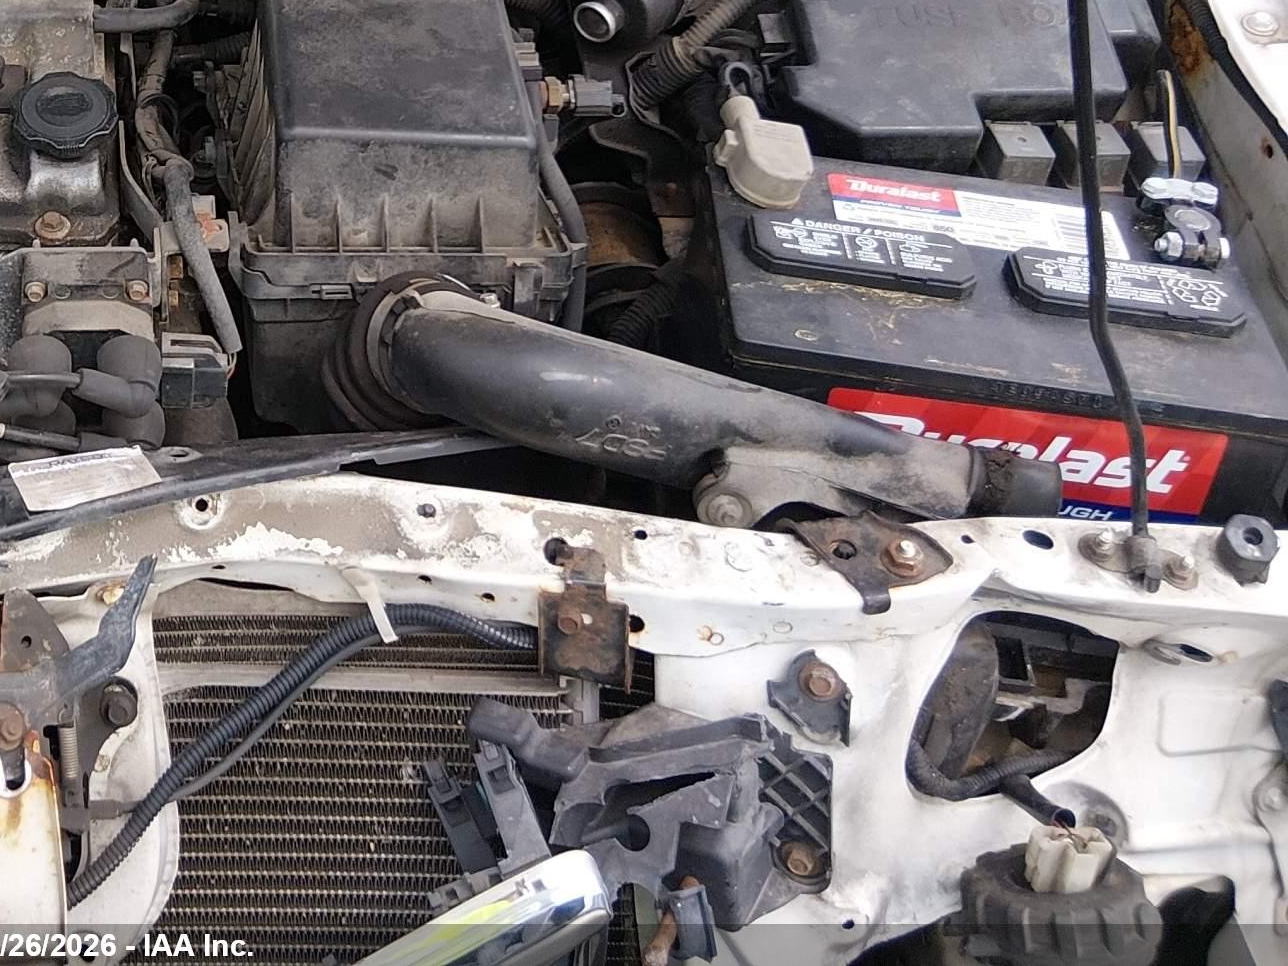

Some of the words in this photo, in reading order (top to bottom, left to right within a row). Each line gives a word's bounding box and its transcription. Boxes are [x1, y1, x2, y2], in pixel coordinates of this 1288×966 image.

[996, 2, 1070, 28] BO
[845, 178, 942, 203] Duralast
[804, 218, 863, 235] DANGER
[874, 228, 926, 243] POISON
